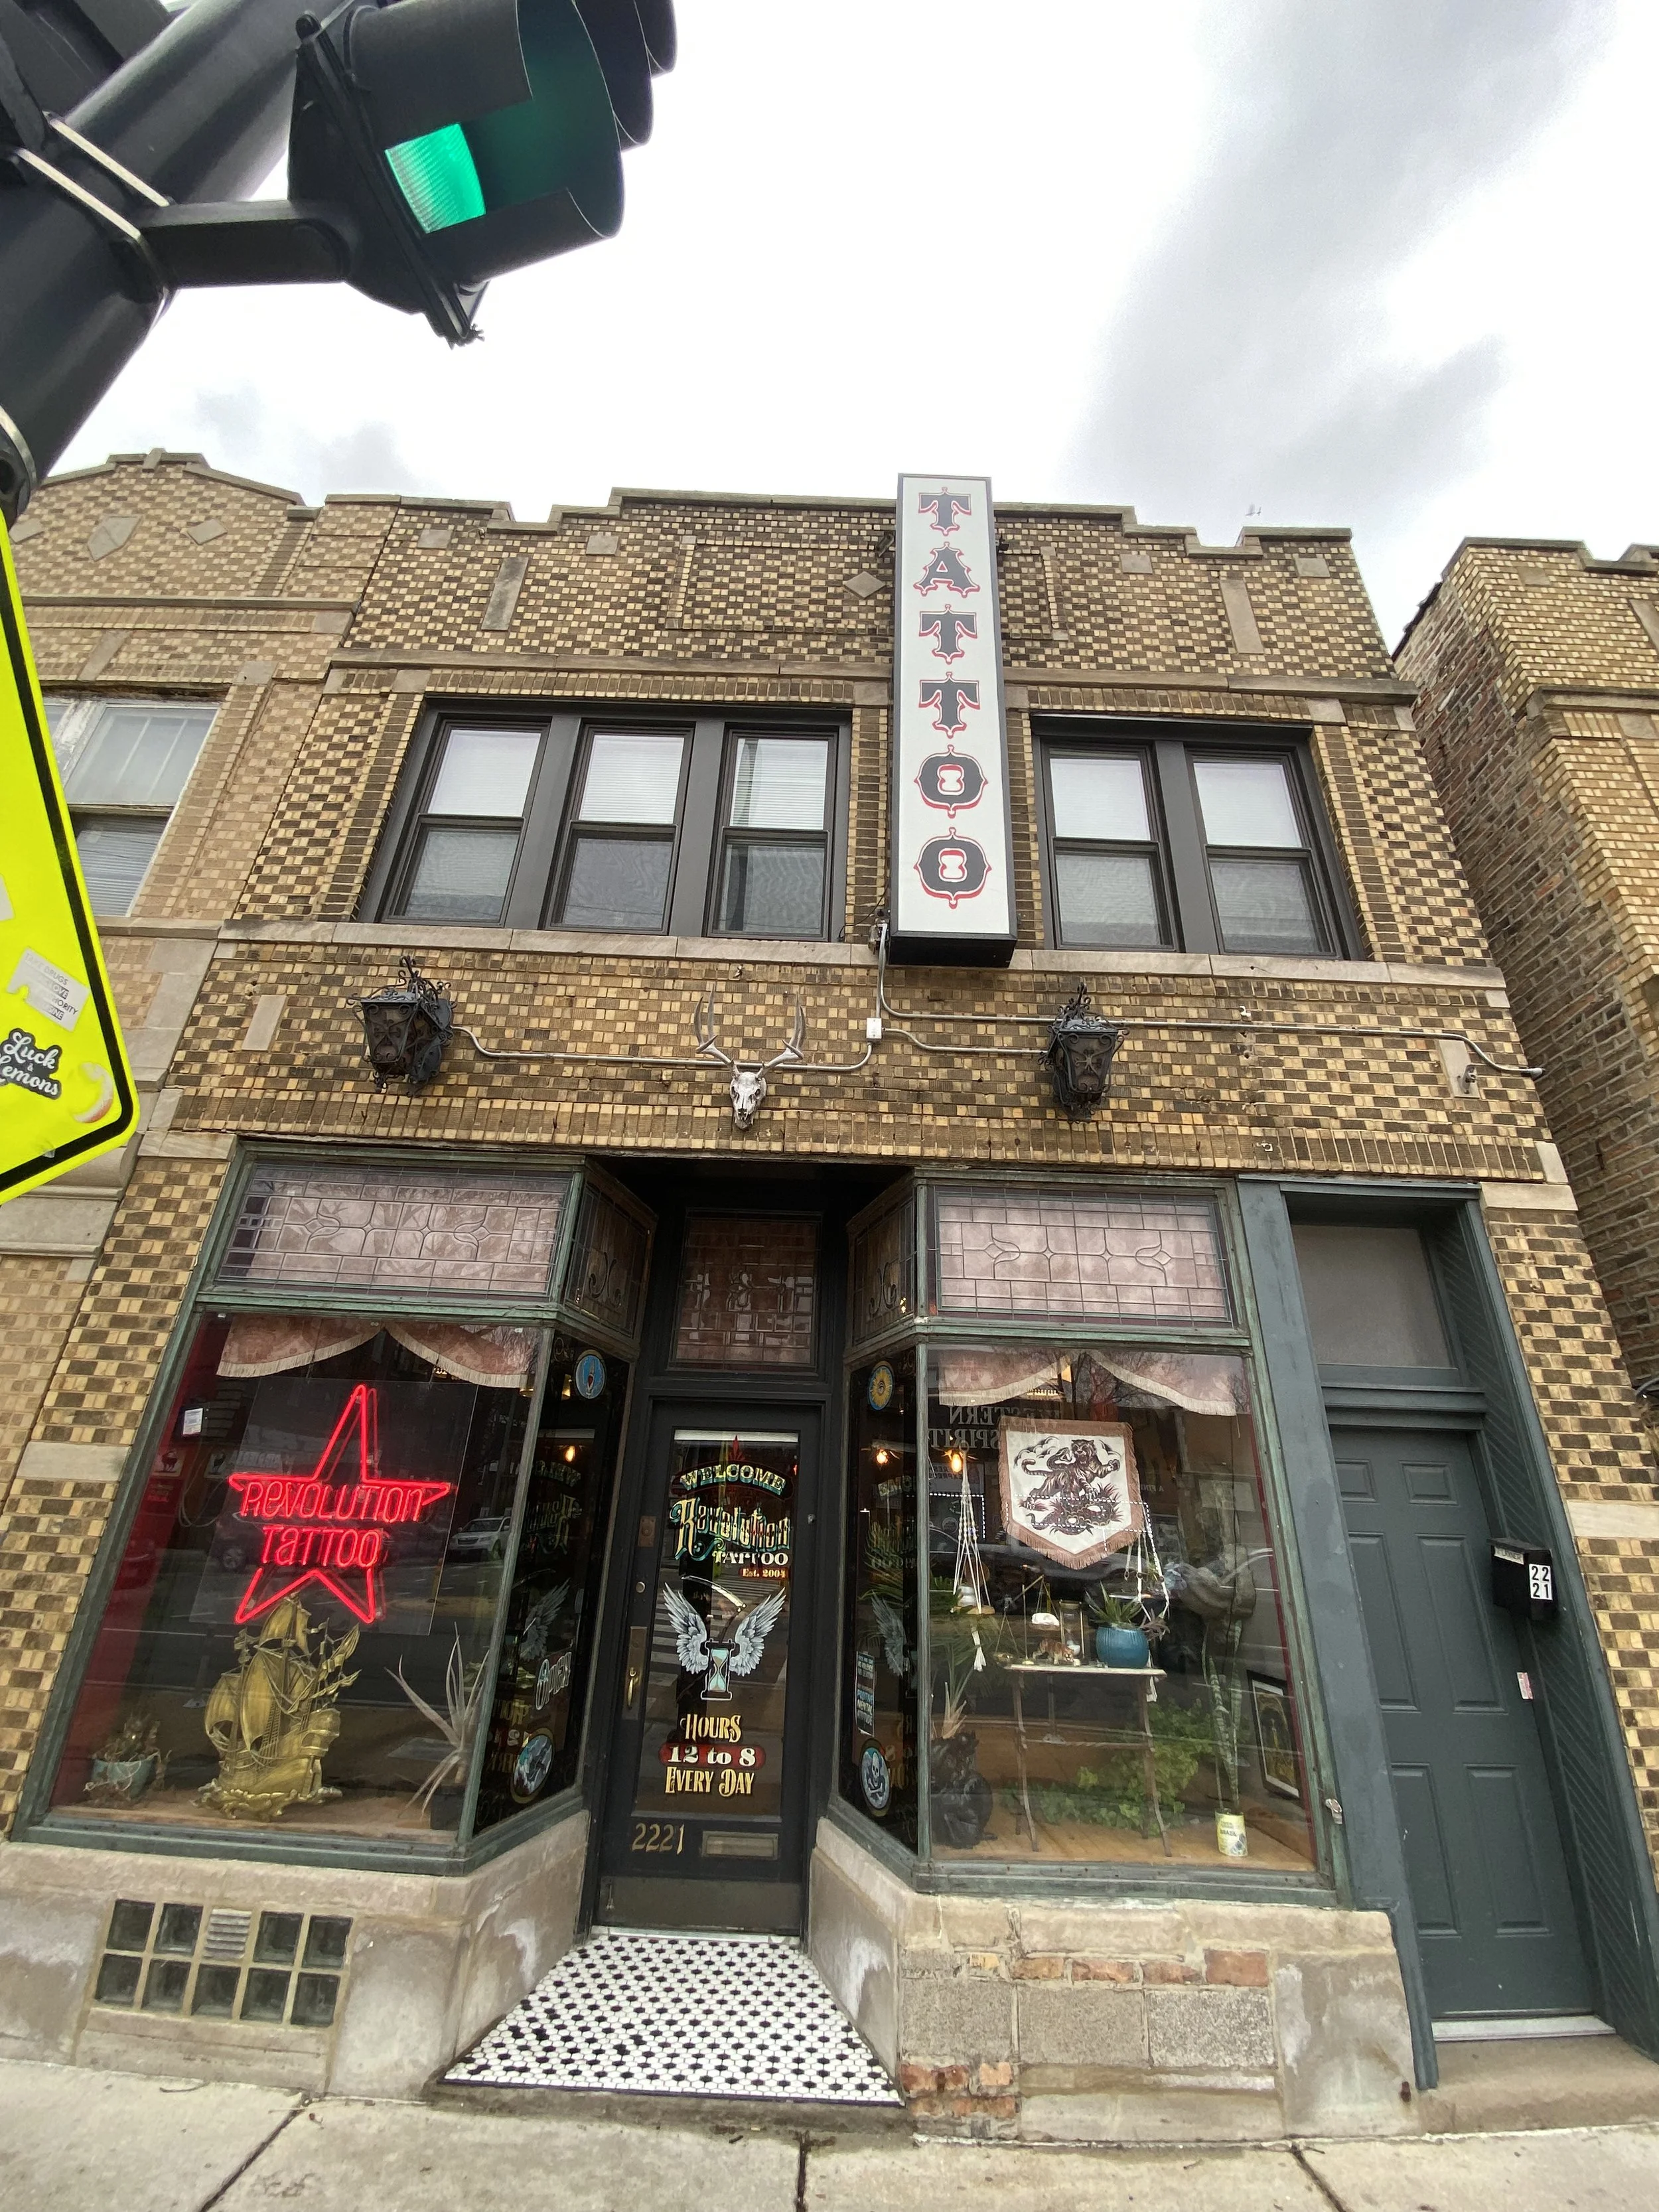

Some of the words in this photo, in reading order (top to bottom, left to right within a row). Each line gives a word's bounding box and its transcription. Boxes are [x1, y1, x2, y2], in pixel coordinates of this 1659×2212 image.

[913, 486, 991, 909] TATTOO
[44, 966, 68, 986] DRUGS
[3, 1032, 59, 1069] Luck
[680, 1463, 786, 1495] WELCOME
[712, 1550, 789, 1566] TATTOO
[762, 1568, 786, 1578] 2004
[1532, 1566, 1550, 1582] 22
[1532, 1582, 1550, 1599] 21
[680, 1713, 743, 1743] HOURS
[667, 1745, 699, 1764] 12
[707, 1747, 732, 1765] to
[739, 1747, 757, 1767] 8
[664, 1766, 714, 1795] EVERY
[718, 1768, 755, 1798] DAY
[631, 1822, 685, 1856] 2221
